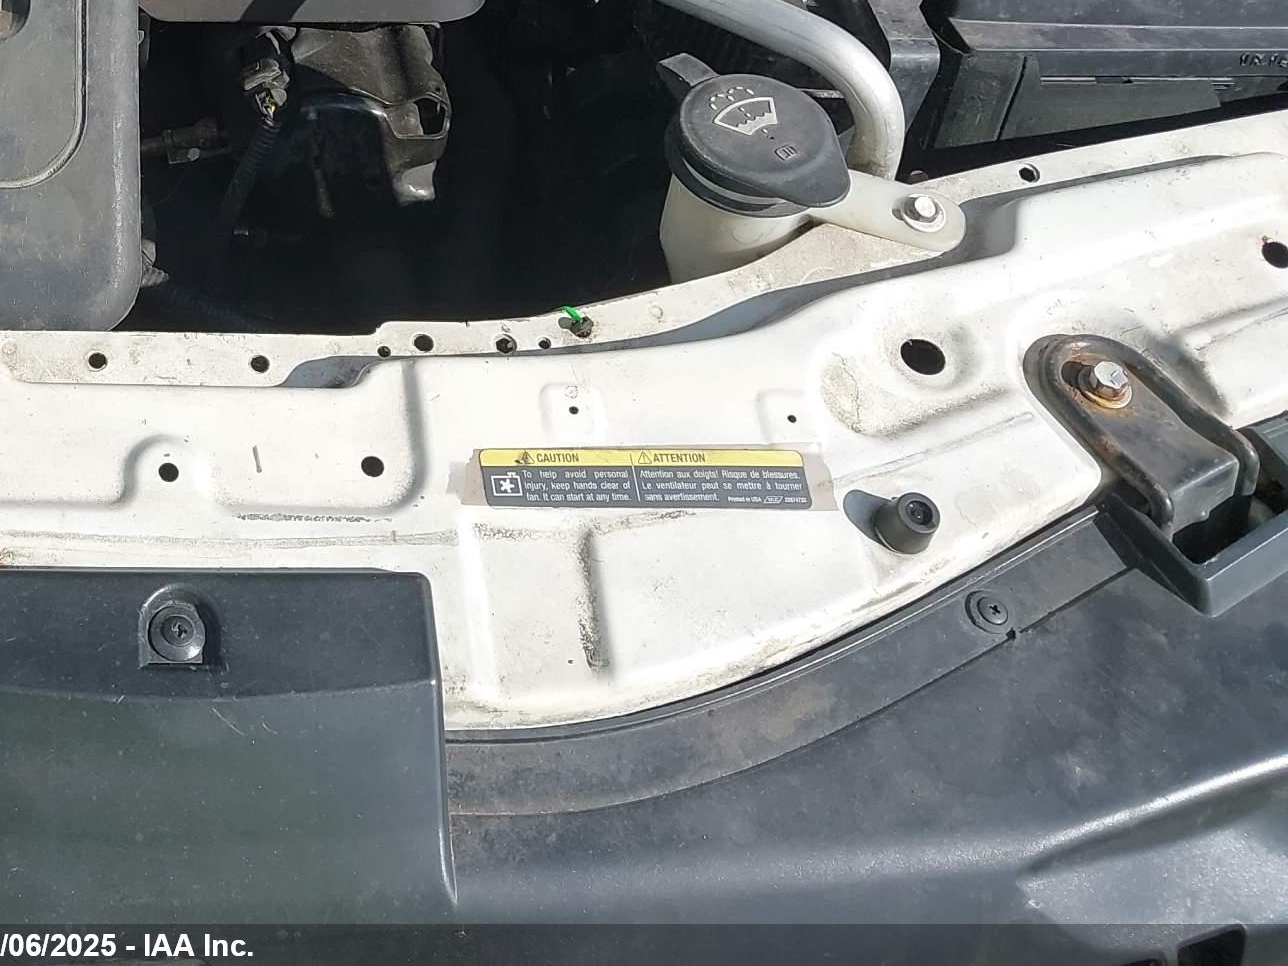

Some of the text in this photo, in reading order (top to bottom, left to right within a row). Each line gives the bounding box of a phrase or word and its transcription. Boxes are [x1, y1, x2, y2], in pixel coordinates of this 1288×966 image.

[536, 453, 579, 463] CAUTION
[653, 453, 706, 463] ATTENTION
[523, 470, 628, 480] To help avoid personal
[640, 469, 674, 478] Attention
[693, 470, 718, 480] doigts!
[721, 470, 747, 480] Risque
[750, 470, 760, 478] de
[763, 470, 800, 479] blessures.
[551, 481, 570, 491] keep
[573, 481, 597, 490] hands
[600, 481, 619, 490] clear
[622, 481, 631, 490] of
[642, 482, 652, 490] Le
[656, 482, 697, 490] ventilateur
[701, 482, 719, 491] peut
[736, 482, 762, 490] mettre
[766, 481, 772, 490] à
[775, 482, 802, 491] tourner
[526, 493, 541, 501] fan.
[543, 493, 550, 501] It
[566, 493, 585, 501] start
[586, 493, 595, 501] at
[596, 494, 610, 503] any
[611, 493, 633, 502] time.
[664, 493, 720, 502] avertissement.
